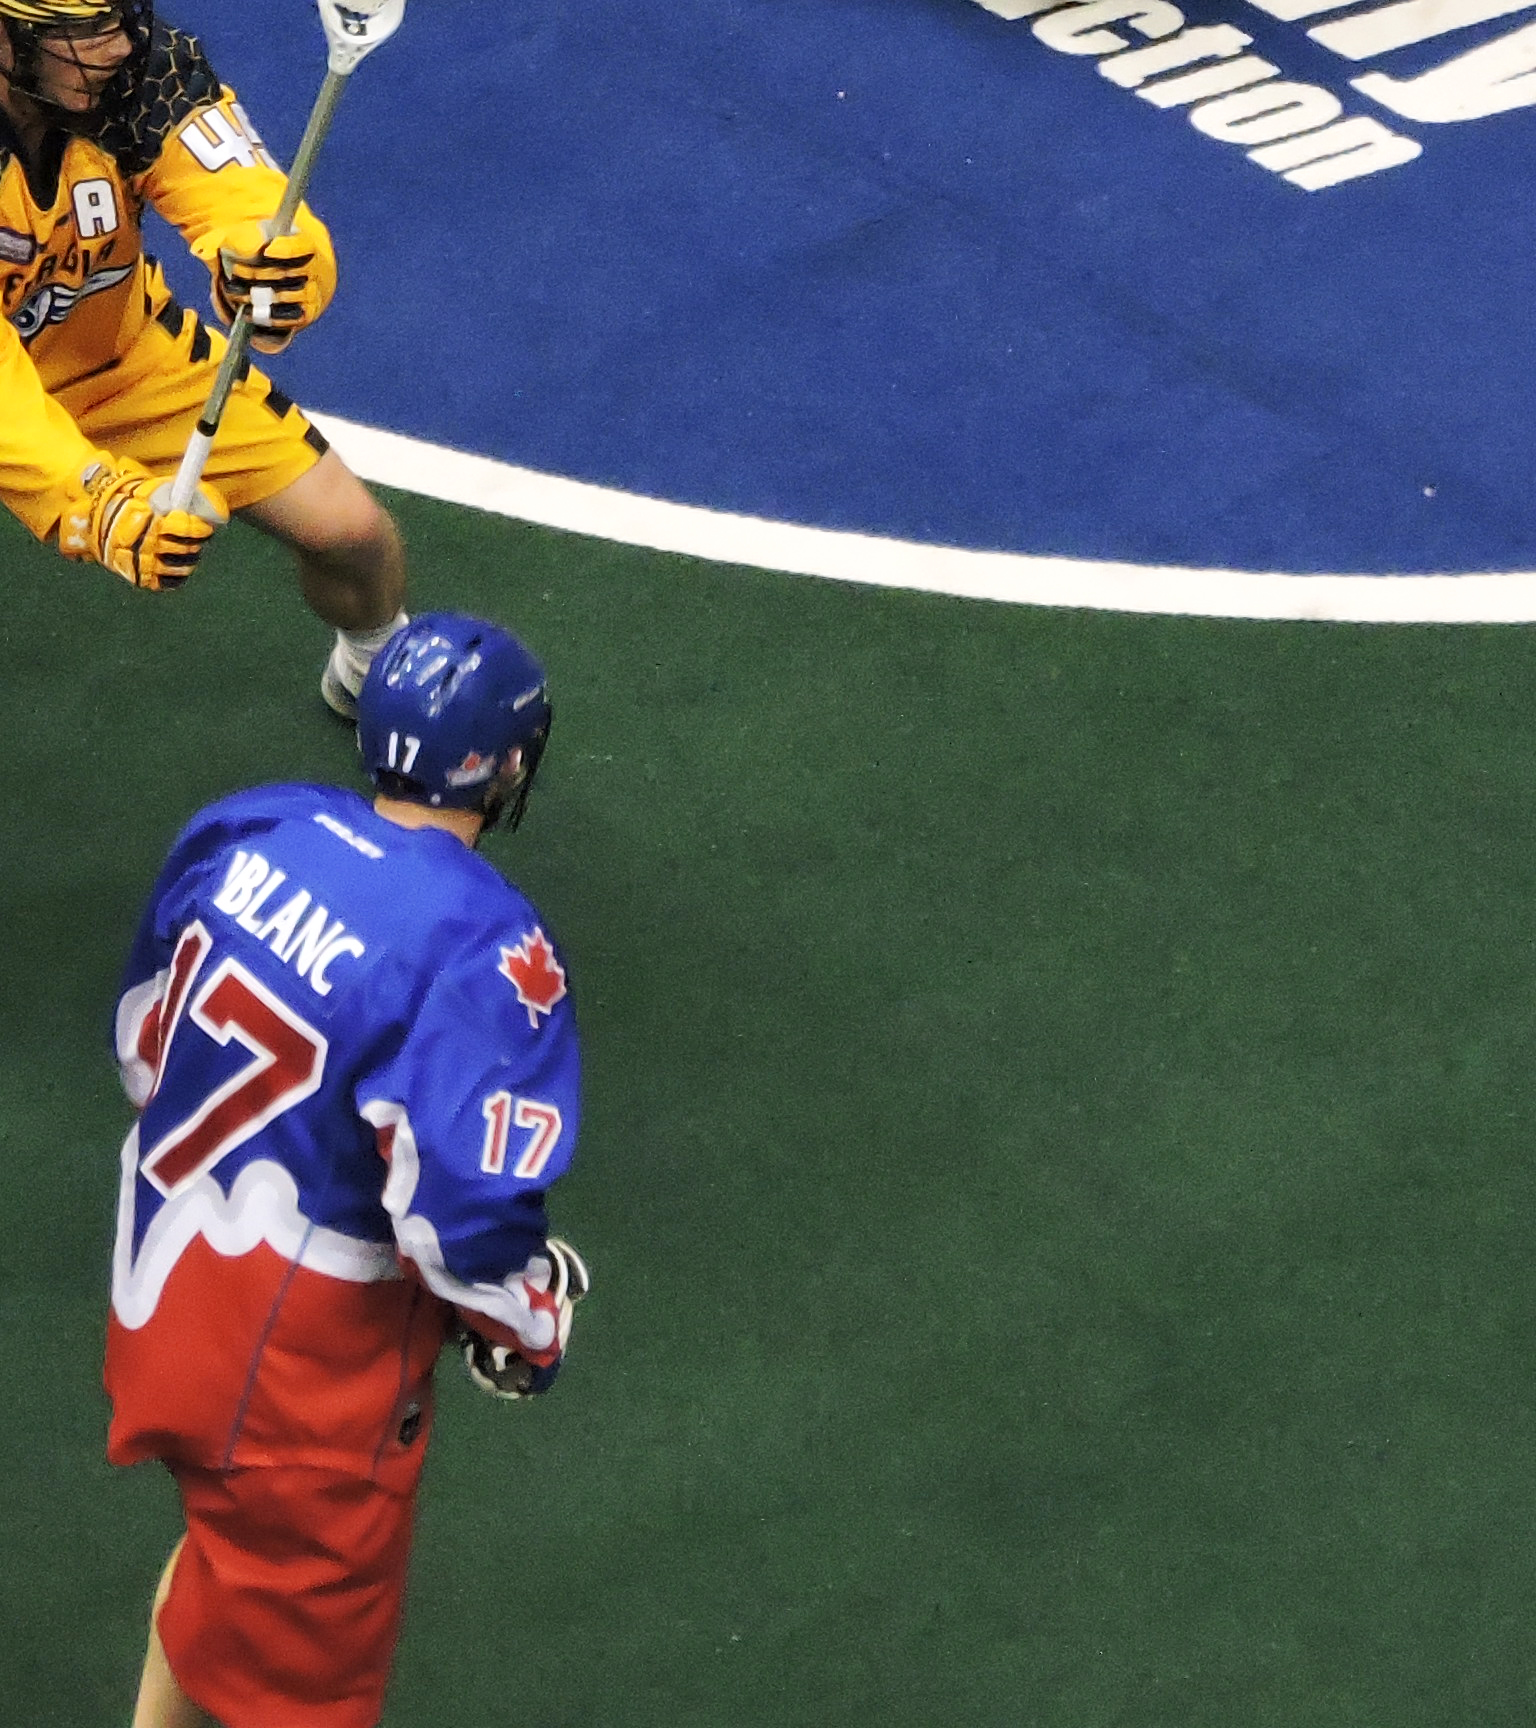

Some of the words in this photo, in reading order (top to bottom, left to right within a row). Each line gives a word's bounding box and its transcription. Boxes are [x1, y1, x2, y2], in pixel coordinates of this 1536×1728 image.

[72, 178, 119, 240] A
[387, 731, 421, 774] 17
[213, 849, 366, 997] BLANC
[140, 918, 329, 1200] 17
[480, 1089, 562, 1178] 17
